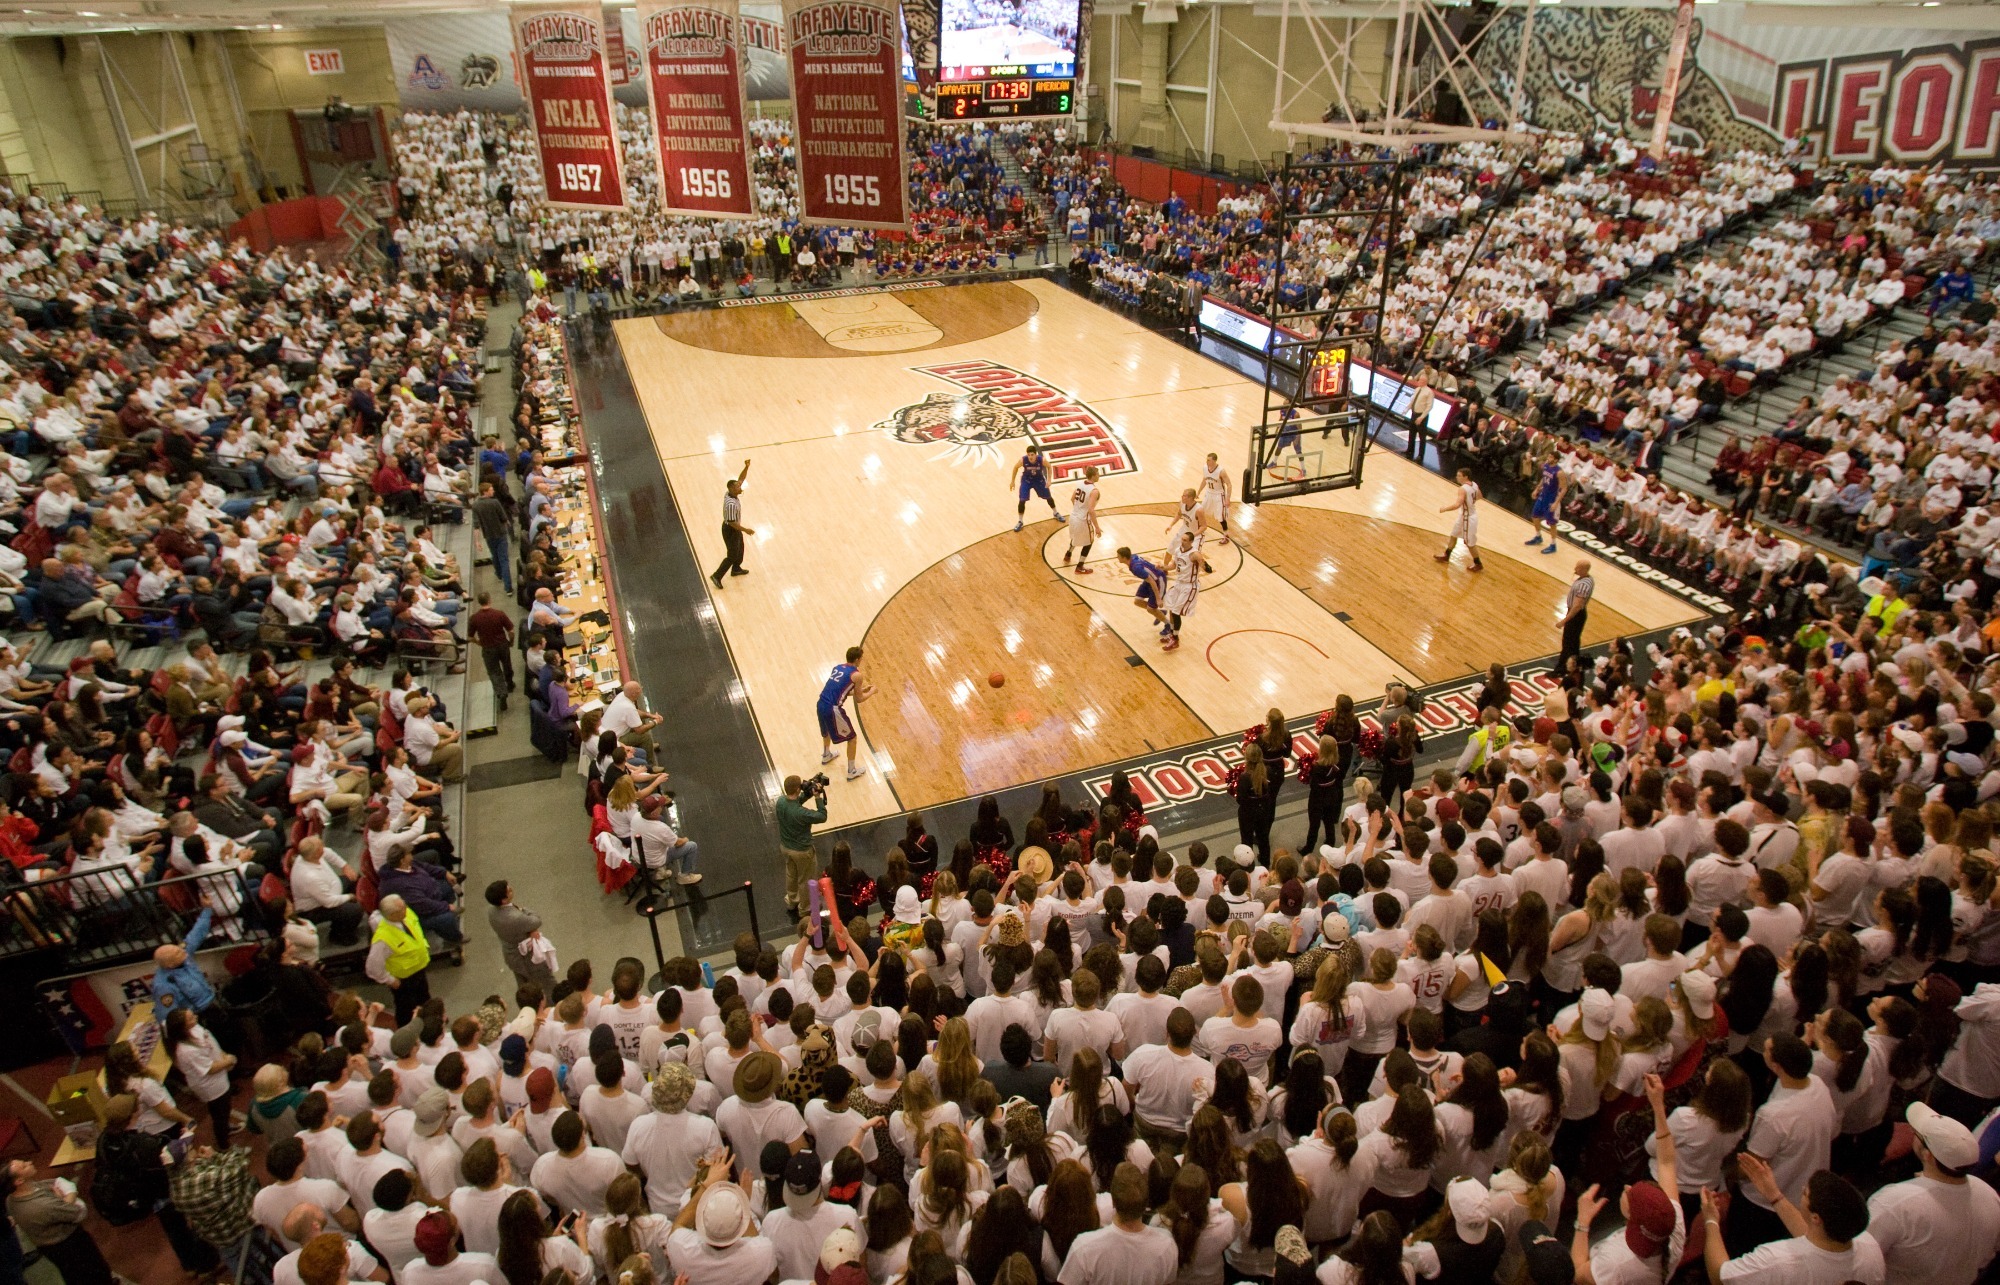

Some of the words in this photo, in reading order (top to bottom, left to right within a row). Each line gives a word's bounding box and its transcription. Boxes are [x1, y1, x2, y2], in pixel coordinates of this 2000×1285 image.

[521, 15, 600, 49] LAFAYETTE
[646, 8, 733, 46] LAFAYETTE
[791, 4, 893, 44] LAFAYETTE
[534, 41, 589, 58] LEOPARDS
[660, 38, 723, 55] LEOPARDS
[807, 34, 878, 53] LEOPARDS
[308, 53, 340, 71] EXIT
[658, 64, 681, 75] MEN'S
[683, 64, 730, 75] BASKETBALL
[804, 63, 830, 75] MEN'S
[832, 63, 884, 75] BASKETBALL
[533, 66, 554, 77] MEN'S
[555, 66, 596, 77] BASKETBALL
[937, 84, 982, 96] LAFAYETTE
[990, 81, 1030, 99] 17:39
[1035, 81, 1070, 92] AMERICAN
[668, 93, 725, 109] NATIONAL
[814, 94, 878, 111] NATIONAL
[955, 98, 966, 116] 2
[1060, 95, 1069, 111] 3
[989, 105, 1009, 113] PERIOD
[542, 99, 601, 128] NCAA
[666, 115, 731, 131] INVITATION
[811, 117, 885, 135] INVITATION
[541, 133, 610, 150] TOURNAMENT
[663, 136, 740, 152] TOURNAMENT
[805, 140, 893, 158] TOURNAMENT
[557, 163, 602, 192] 1957
[680, 167, 732, 198] 1956
[824, 174, 880, 206] 1955
[1312, 348, 1346, 366] 7:39
[1319, 366, 1340, 393] 13
[918, 361, 1134, 482] LAFAYETTE
[1075, 488, 1086, 503] 20
[1540, 519, 1735, 614] @GoLeopards
[829, 669, 844, 682] 22
[1412, 969, 1444, 998] 15
